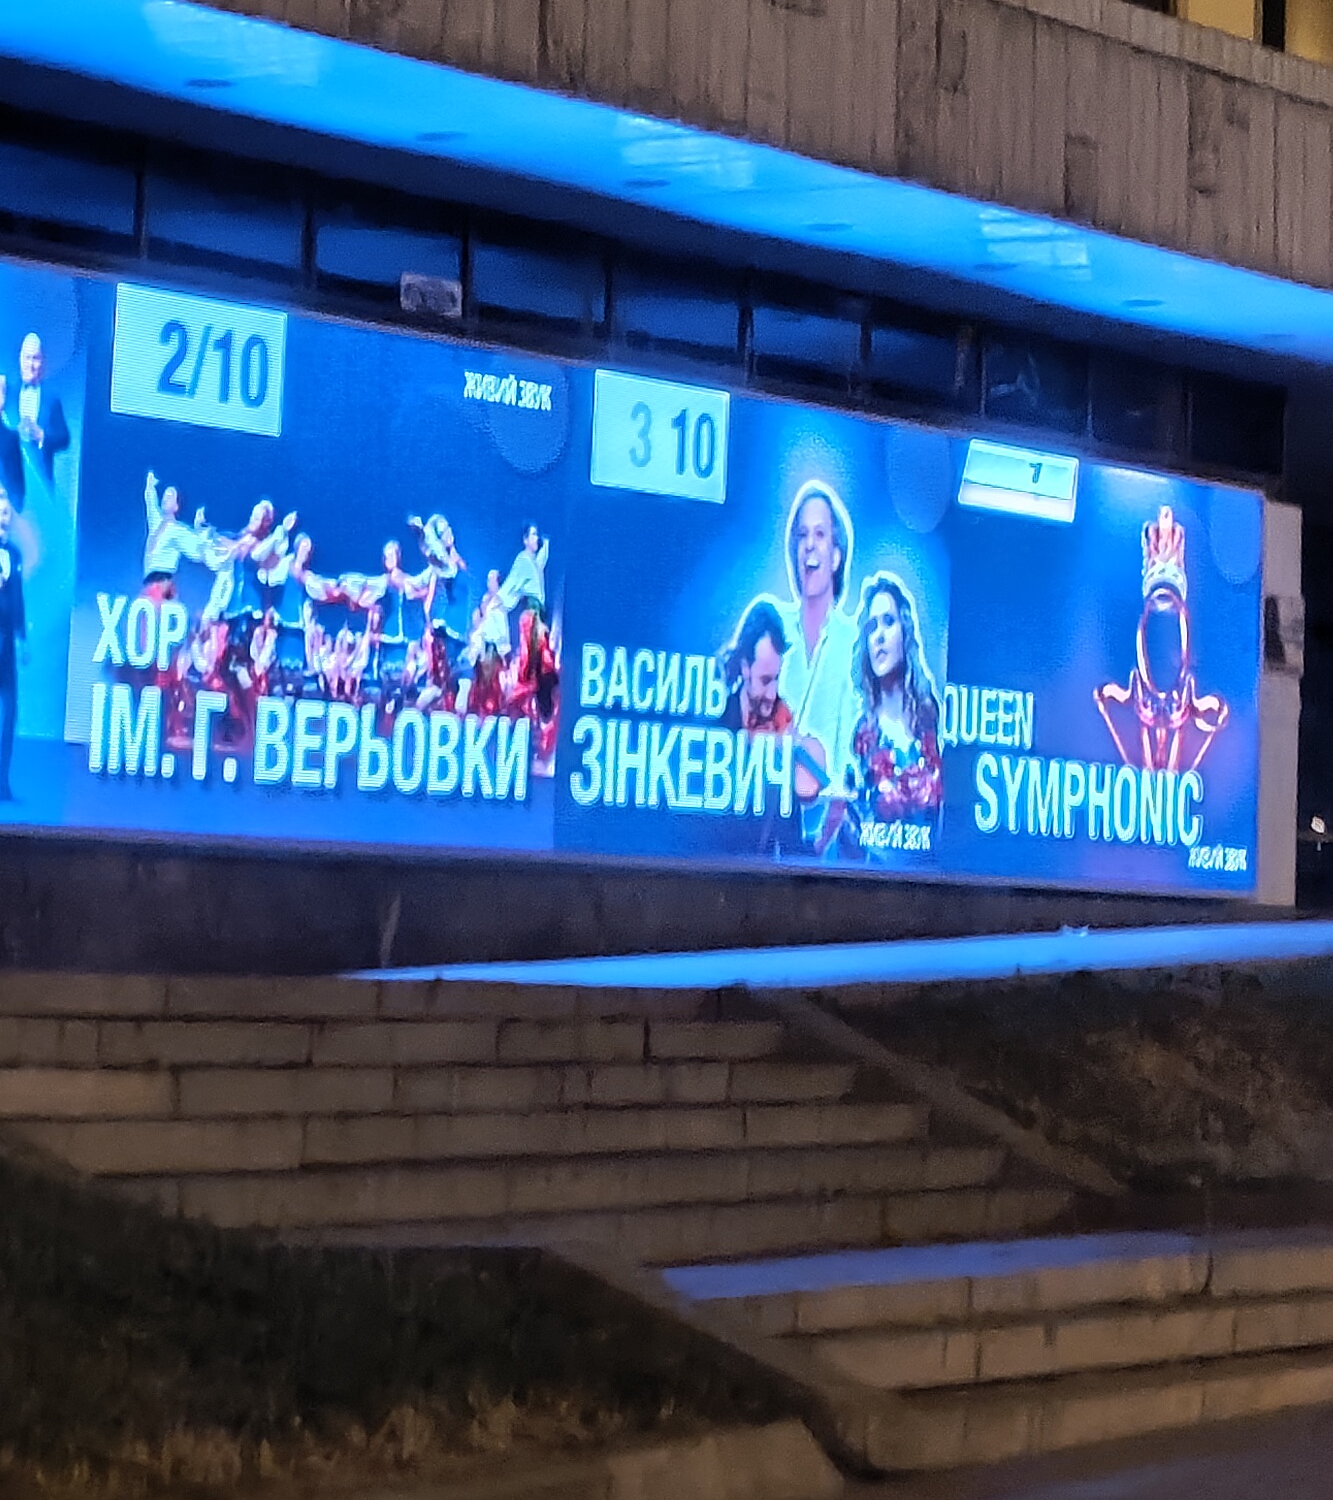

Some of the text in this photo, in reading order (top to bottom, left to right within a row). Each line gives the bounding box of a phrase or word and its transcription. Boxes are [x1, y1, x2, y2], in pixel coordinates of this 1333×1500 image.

[157, 319, 268, 409] 2/10
[628, 401, 715, 479] 3 10
[92, 592, 188, 671] ХОР
[579, 642, 728, 719] ВАСИЛЬ
[942, 682, 1034, 750] QUEEN
[88, 682, 530, 801] ІМ. Г. ВЕРЬОВКИ
[569, 714, 794, 818] ЗІНКЕВИЧ
[973, 751, 1204, 846] SYMPHONIC
